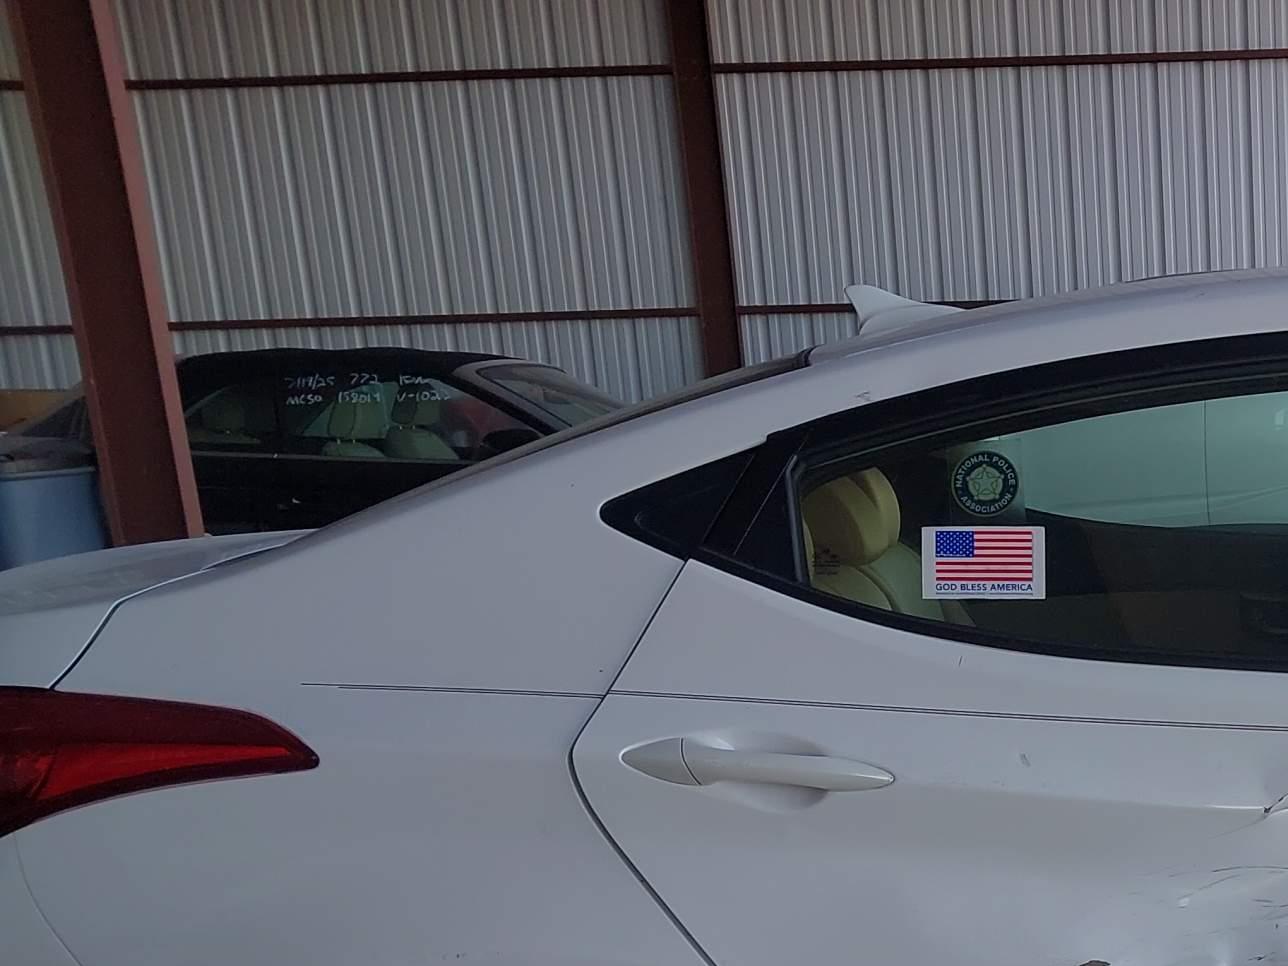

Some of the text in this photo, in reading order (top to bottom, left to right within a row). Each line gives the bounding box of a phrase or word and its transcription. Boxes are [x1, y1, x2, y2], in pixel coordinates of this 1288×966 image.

[955, 454, 1016, 488] NATIONAL POLICE
[960, 493, 1012, 513] ASSOCIATION
[935, 583, 1033, 591] GOD BLESS AMERICA
